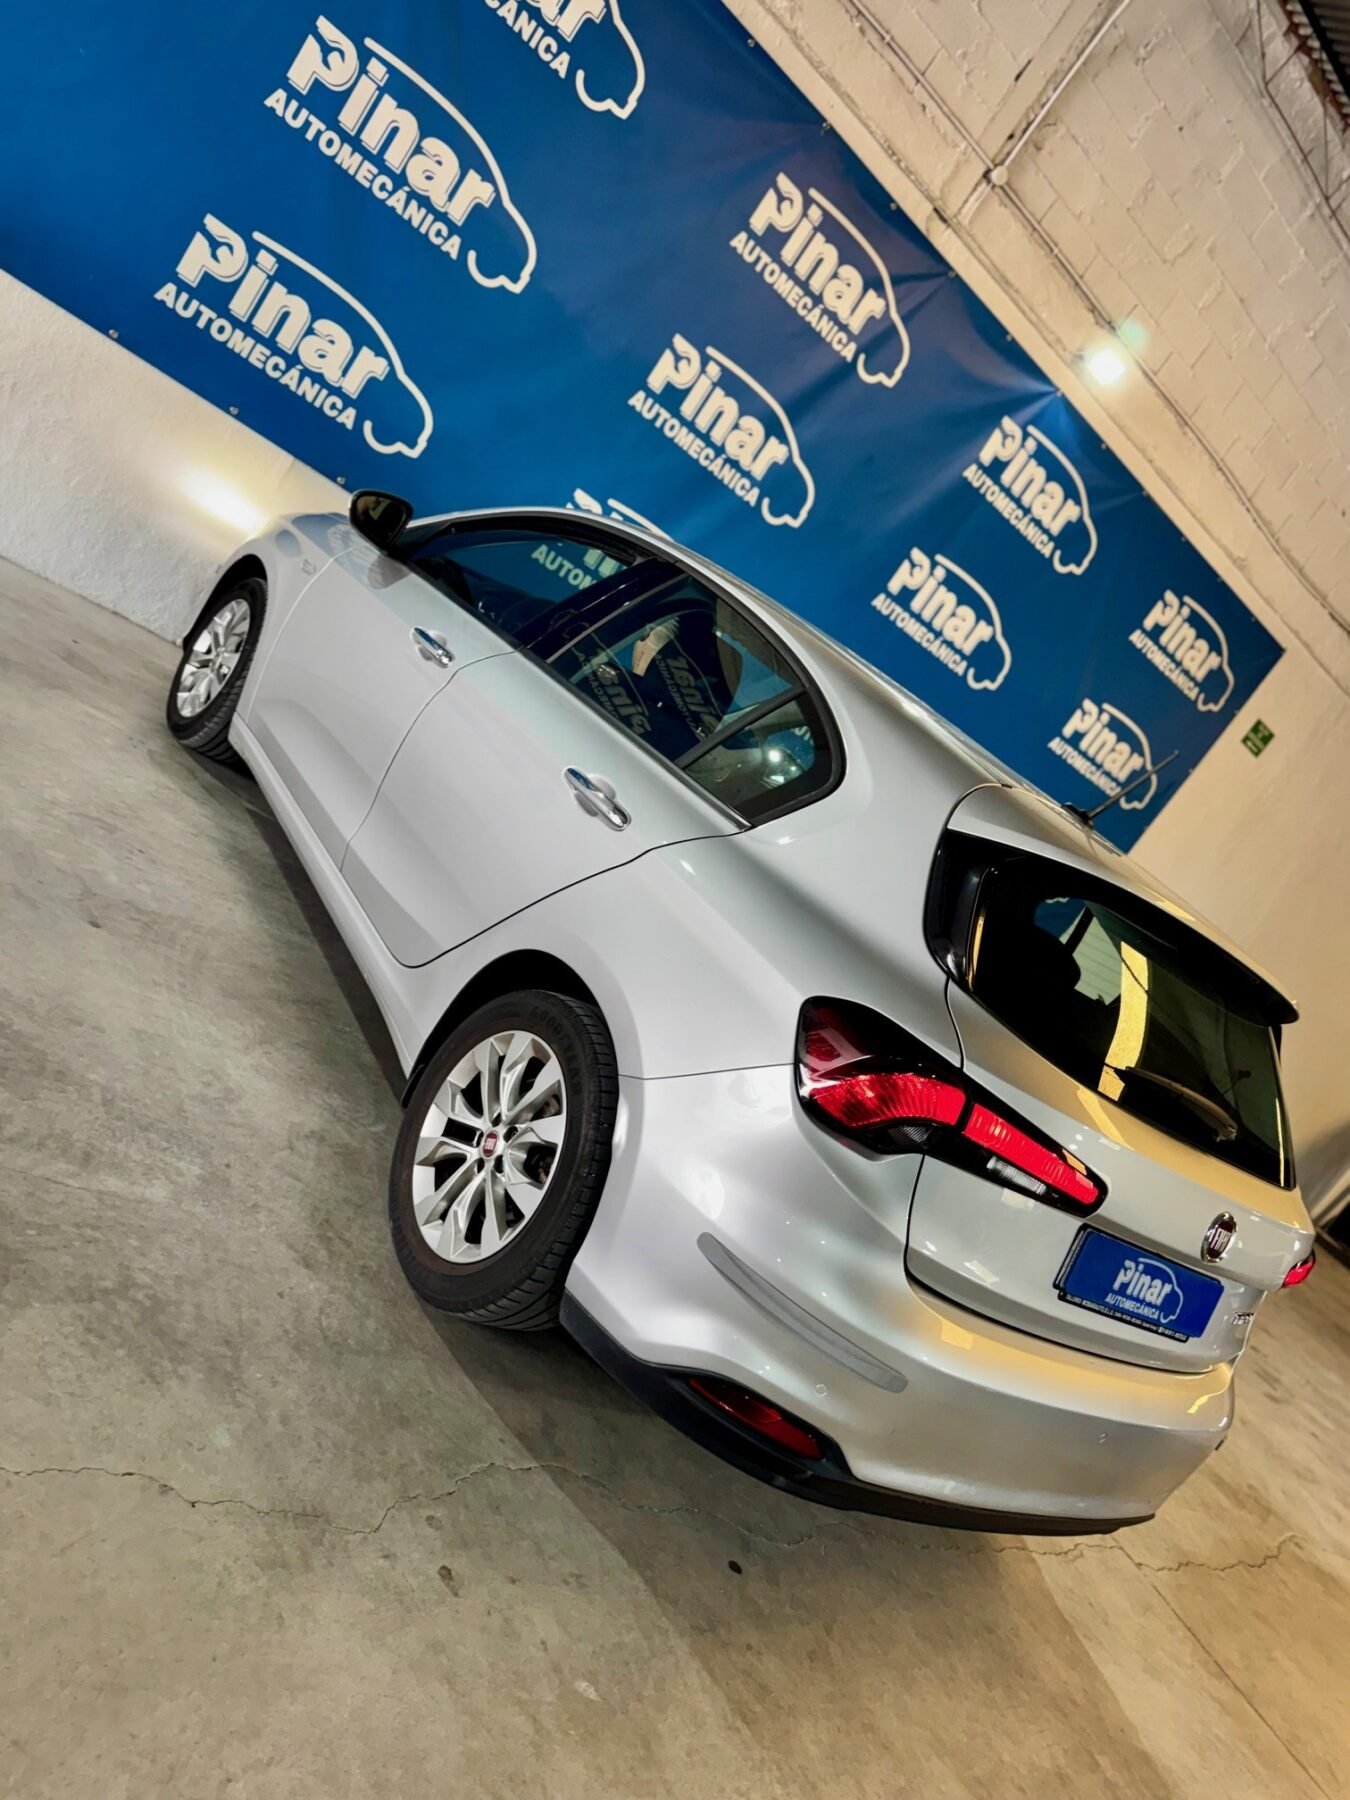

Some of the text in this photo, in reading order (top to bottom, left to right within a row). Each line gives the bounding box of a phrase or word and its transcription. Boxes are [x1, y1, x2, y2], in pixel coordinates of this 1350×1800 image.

[264, 88, 461, 260] AUTOMECÁNICA
[286, 15, 496, 225] Pinar
[176, 213, 390, 399] Pinar
[730, 231, 857, 362] AUTOMECÁNICA
[749, 172, 886, 335] Pinar
[154, 282, 358, 430] AUTOMECÁNICA
[647, 333, 789, 480] Pinar
[628, 390, 760, 507] AUTOMECÁNICA
[979, 415, 1081, 537] Pinar
[962, 463, 1055, 558] AUTOMECÁNICA
[871, 593, 968, 676] AUTOMECÁNICA
[887, 547, 993, 656] Pinar
[1143, 589, 1221, 683] Pinar
[1128, 629, 1200, 700] AUTOMECÁNICA
[1062, 698, 1144, 783] Pinar
[530, 1006, 582, 1095] GOODYEAR
[1104, 1293, 1160, 1319] AUTOMECÁNICA
[1113, 1259, 1173, 1306] Pinar
